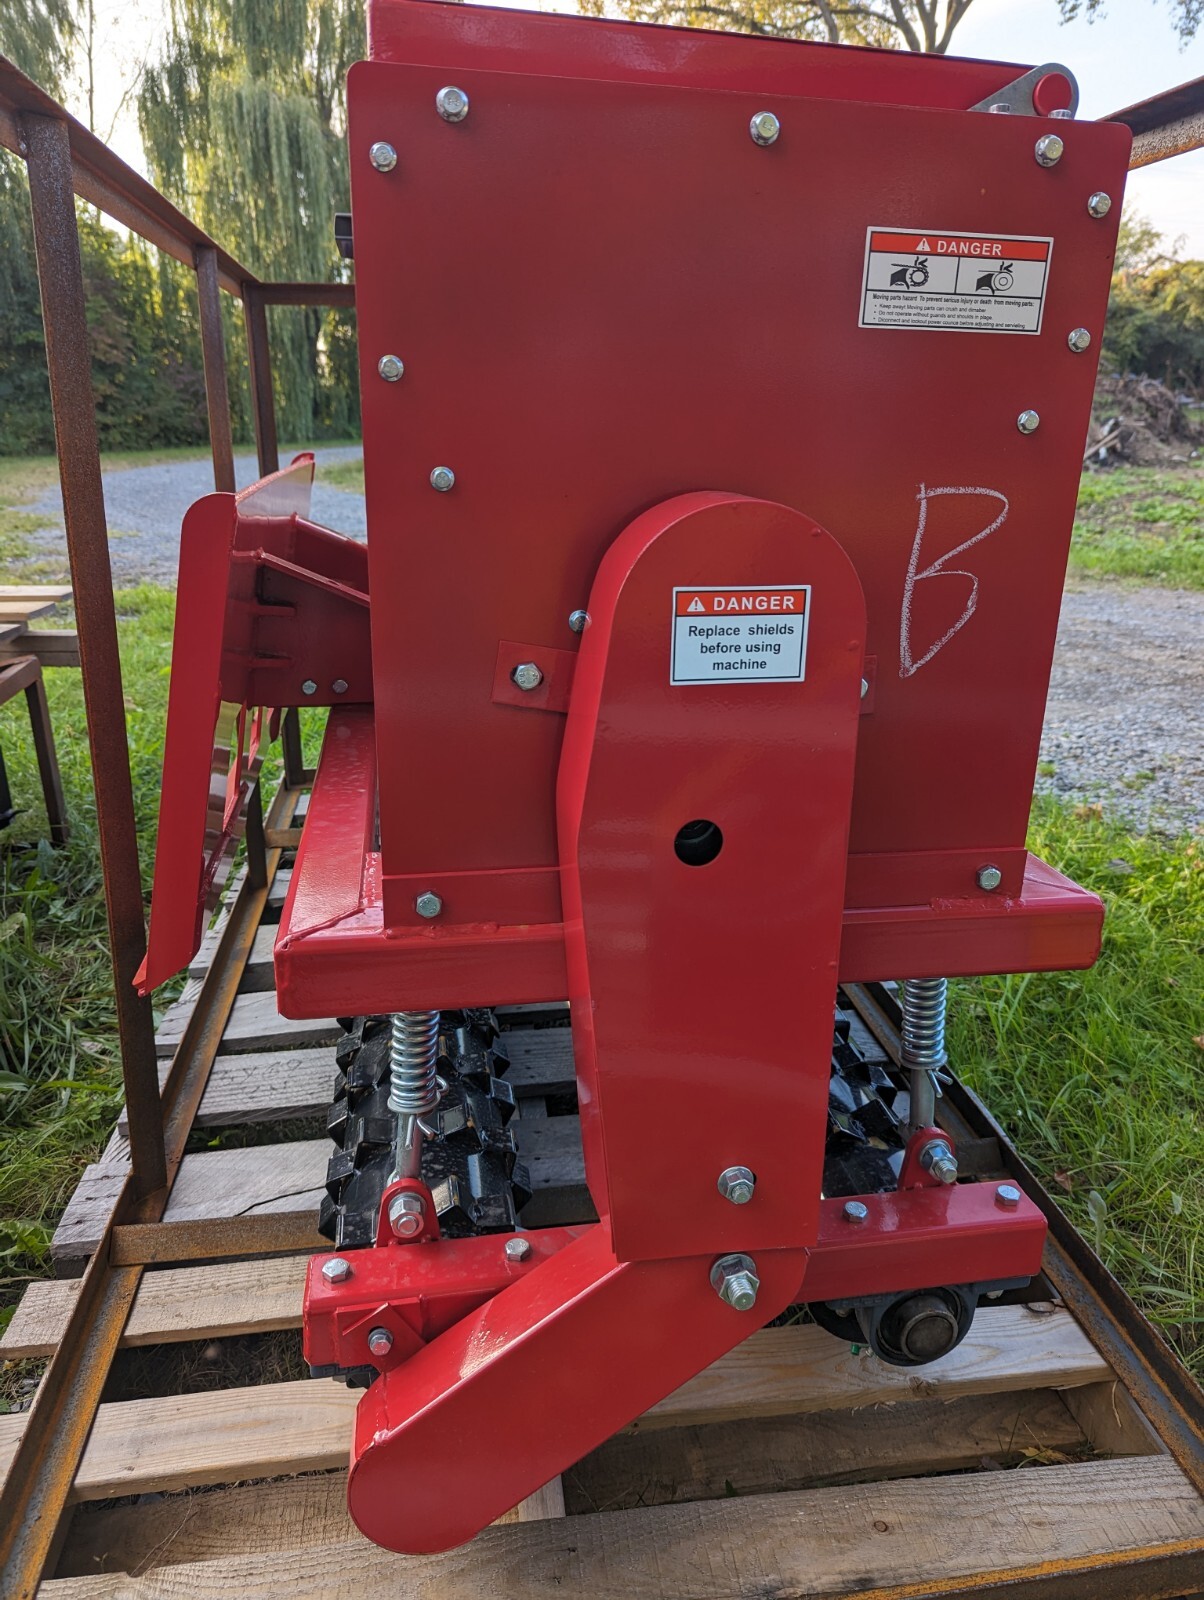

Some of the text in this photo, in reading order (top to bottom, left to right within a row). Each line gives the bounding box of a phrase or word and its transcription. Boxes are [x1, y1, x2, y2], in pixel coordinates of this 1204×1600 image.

[937, 240, 1002, 256] DANGER
[872, 293, 889, 302] Moving
[890, 294, 902, 302] parts
[899, 482, 1009, 679] B
[713, 595, 795, 611] DANGER
[688, 623, 795, 639] Replace shields
[700, 641, 782, 655] before using
[712, 658, 767, 671] machine
